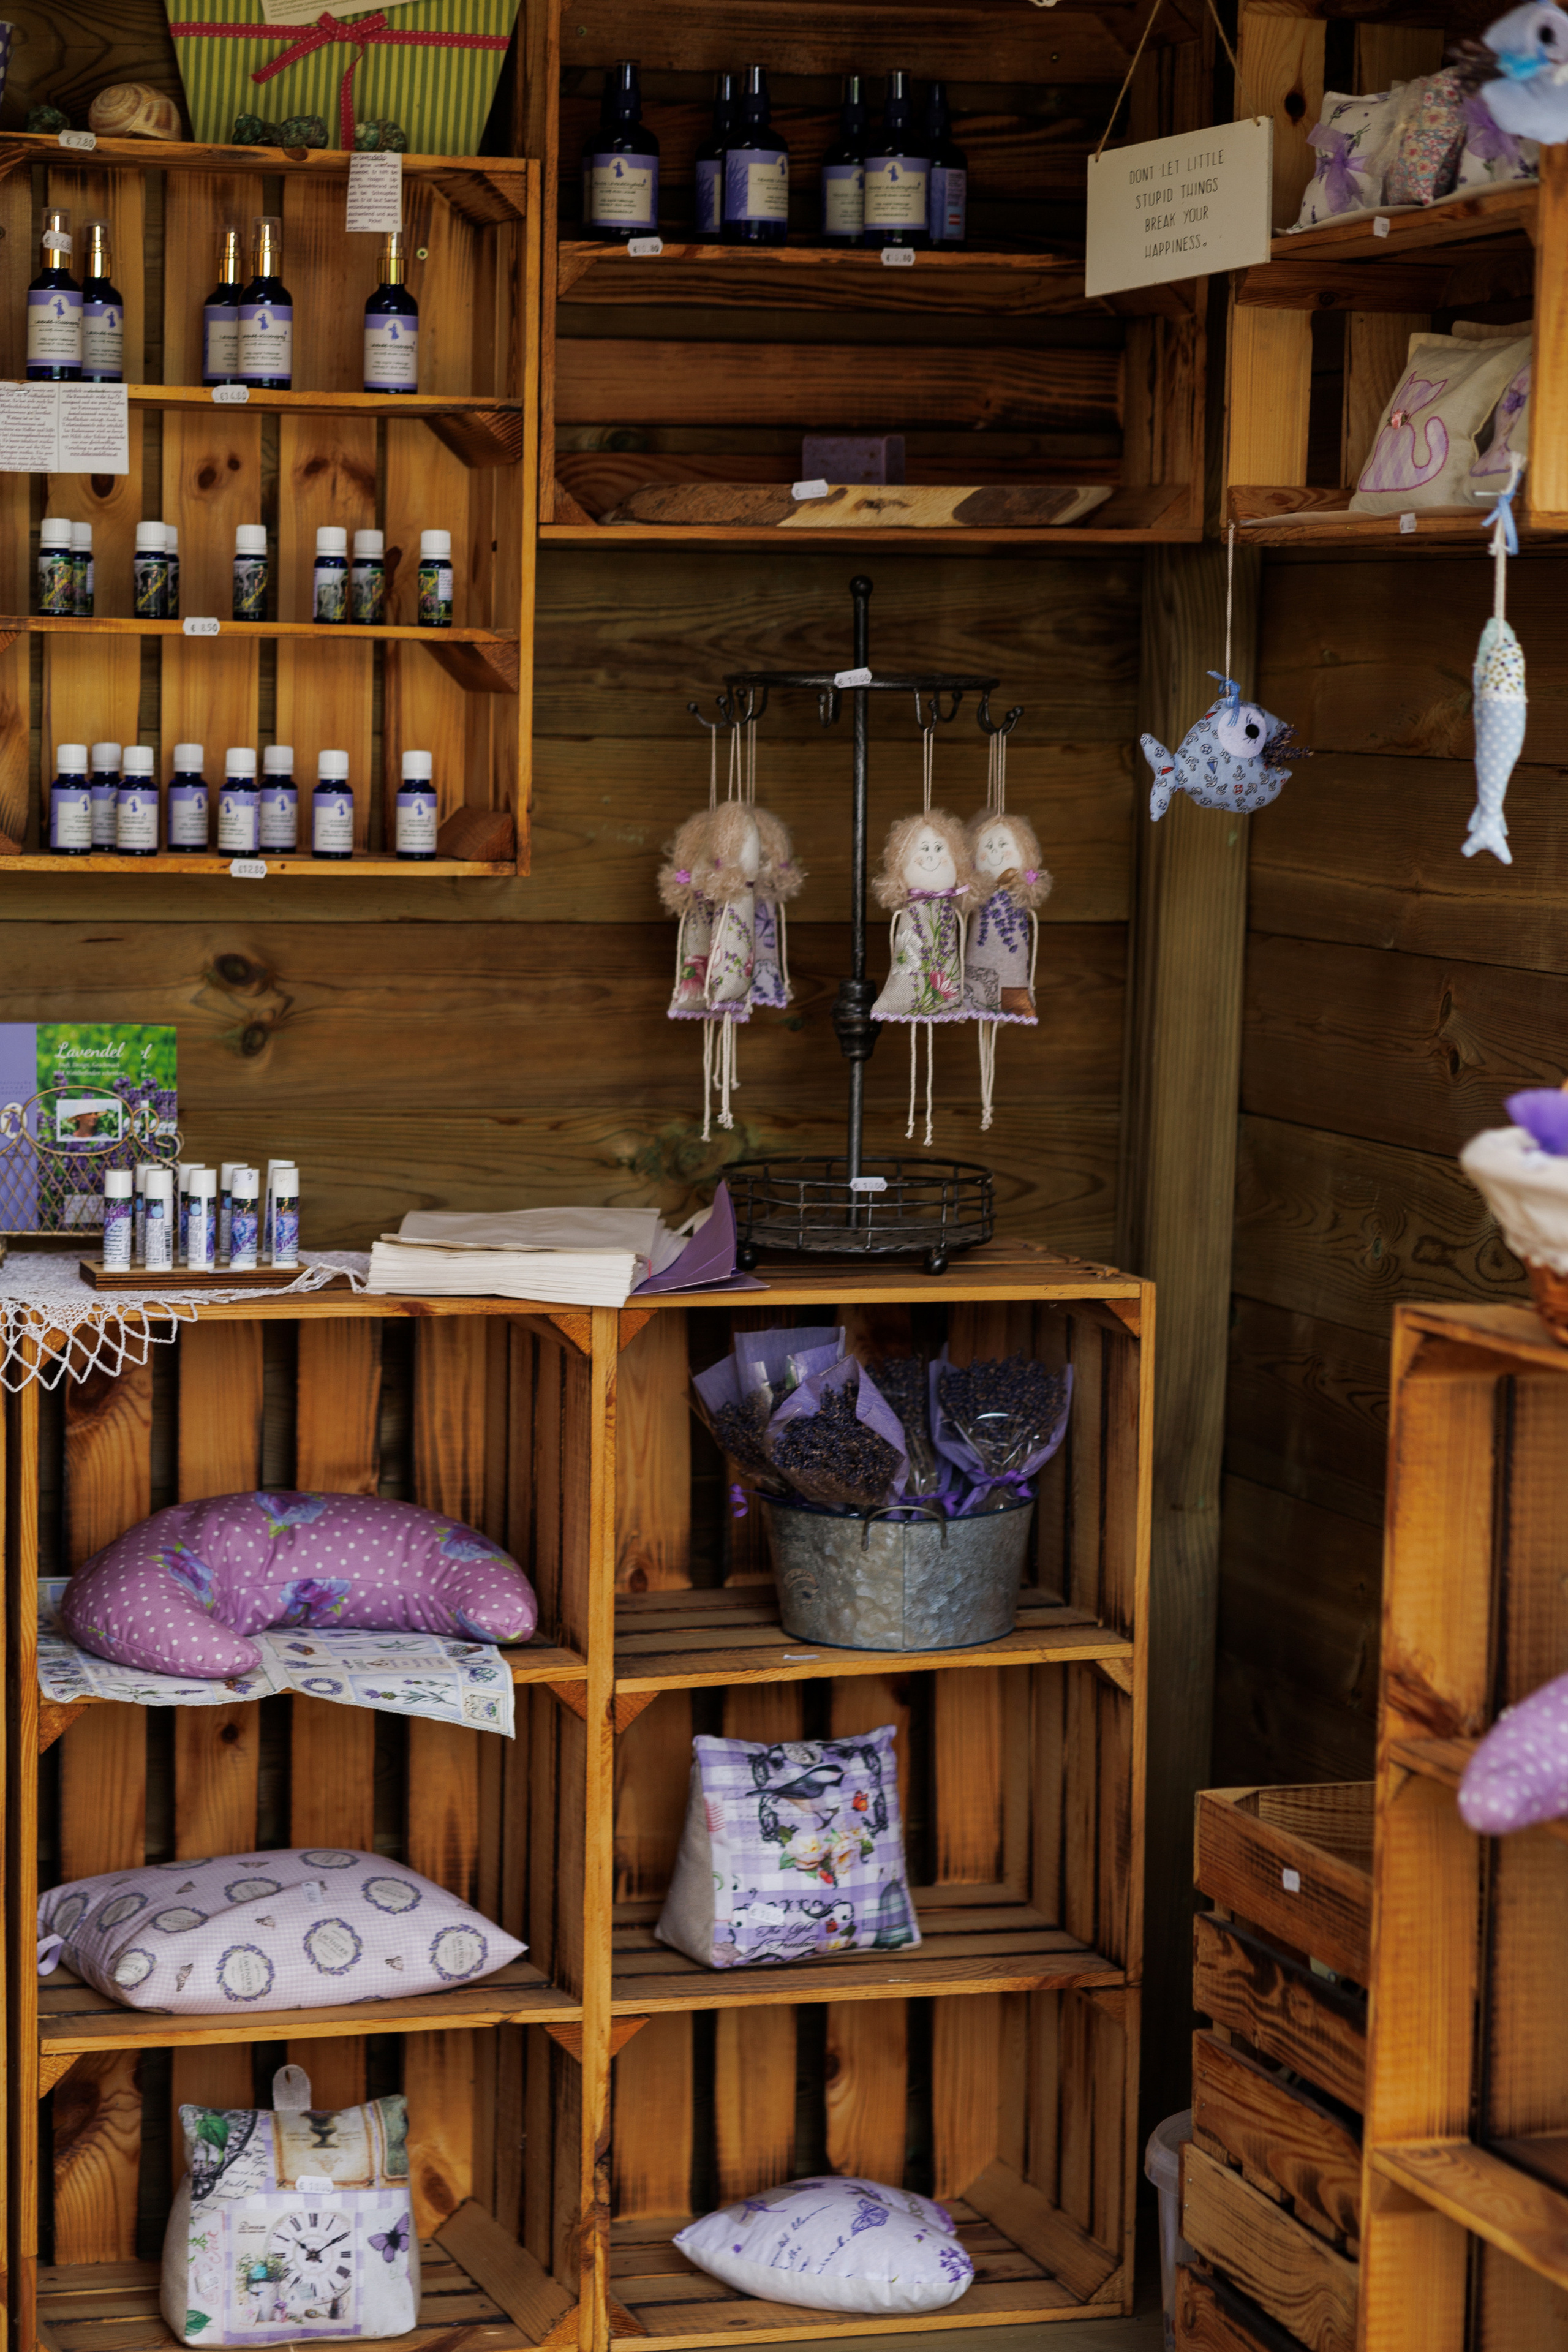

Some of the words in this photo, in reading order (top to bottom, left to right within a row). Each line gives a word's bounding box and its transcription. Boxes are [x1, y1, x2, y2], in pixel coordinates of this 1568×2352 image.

[1129, 165, 1154, 184] DONT
[1161, 159, 1180, 178] LET
[1187, 149, 1224, 172] LITTLE
[1135, 188, 1174, 209] STUPID
[1181, 177, 1219, 199] THINGS
[1145, 212, 1177, 233] BREAK
[1183, 205, 1209, 224] YOUR
[1144, 234, 1207, 259] HAPPINESS.
[54, 1041, 126, 1059] Lavendel
